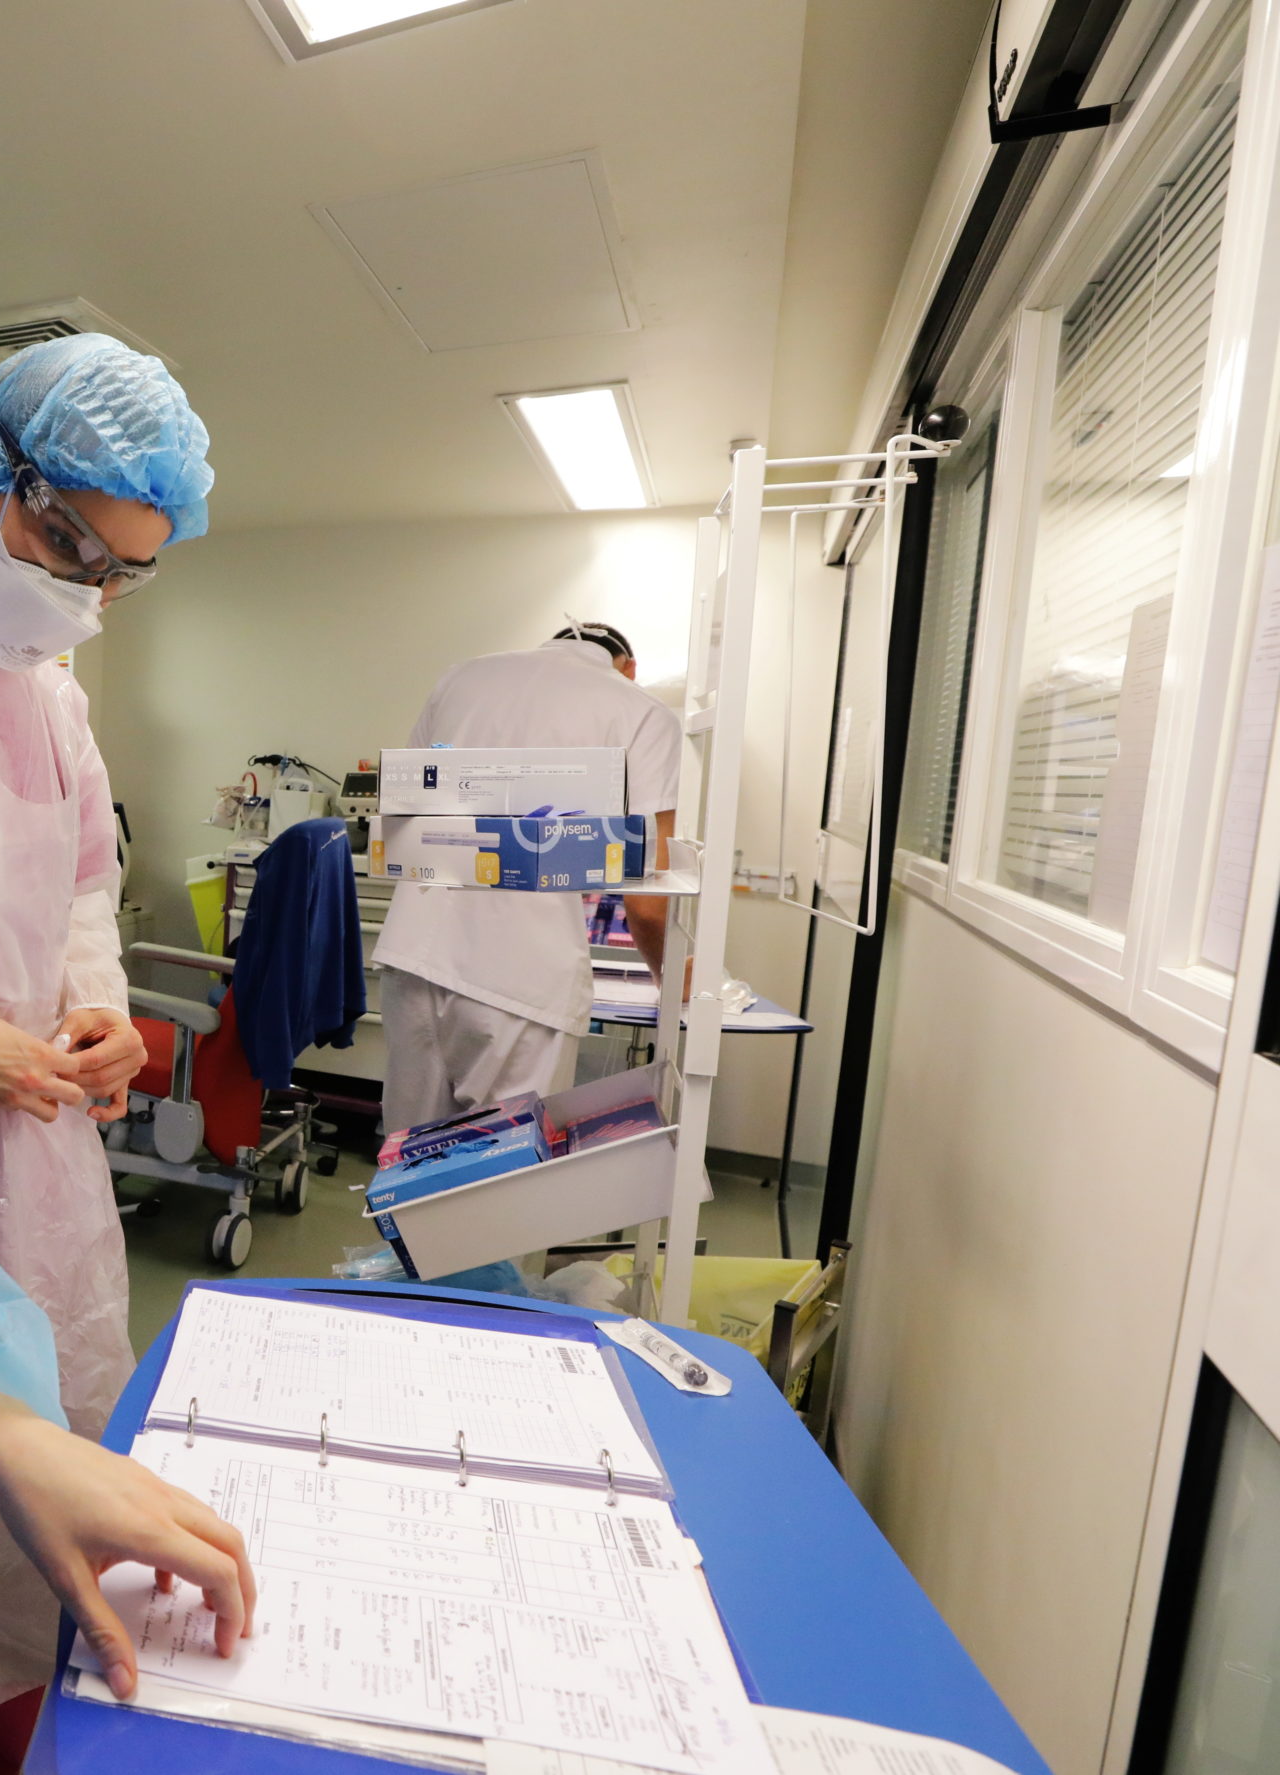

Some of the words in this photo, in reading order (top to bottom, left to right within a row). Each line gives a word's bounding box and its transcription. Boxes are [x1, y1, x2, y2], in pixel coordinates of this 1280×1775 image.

[21, 645, 44, 658] 3M
[385, 773, 398, 782] XS
[401, 773, 408, 782] S
[413, 773, 422, 782] M
[427, 773, 434, 782] L
[439, 773, 450, 782] XL
[544, 824, 592, 838] polysem
[410, 868, 417, 878] S
[420, 867, 435, 879] 100
[486, 870, 492, 880] S
[540, 875, 549, 887] S
[552, 873, 570, 886] 100
[372, 1192, 396, 1204] tenty
